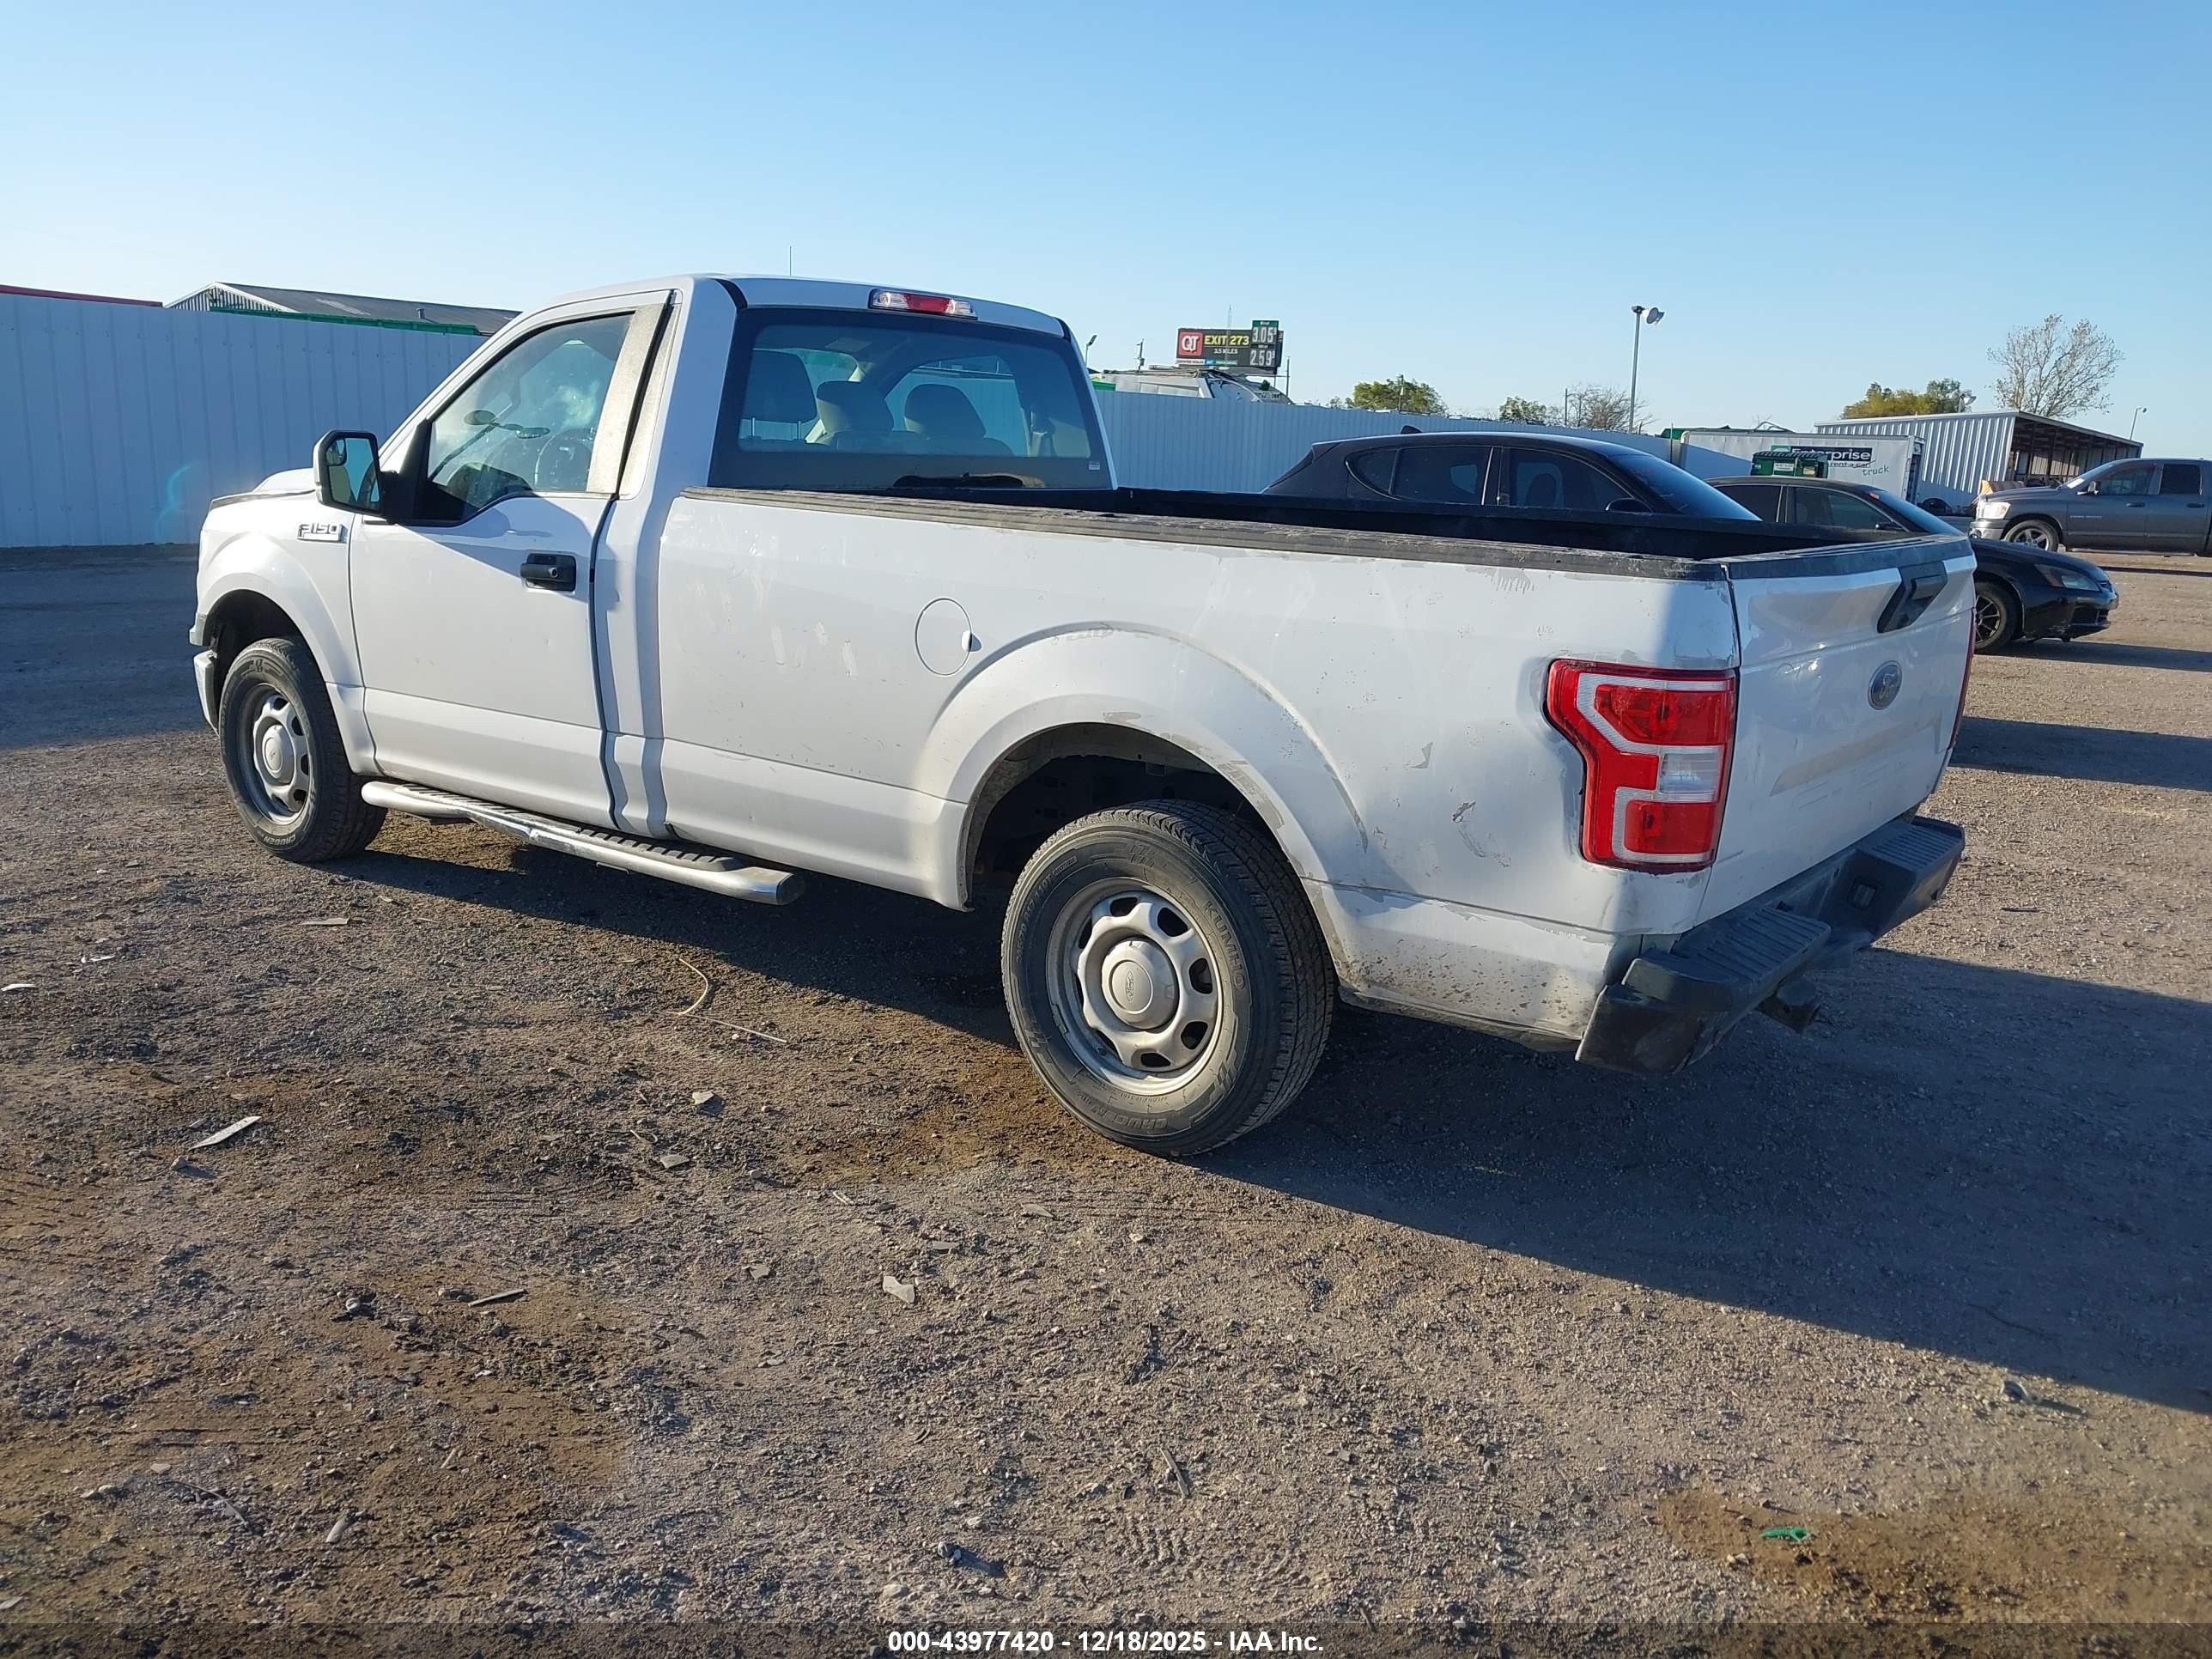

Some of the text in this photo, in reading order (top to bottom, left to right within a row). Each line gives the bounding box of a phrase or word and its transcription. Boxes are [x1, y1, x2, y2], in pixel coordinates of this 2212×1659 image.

[1204, 335, 1250, 347] EXIT 273
[1862, 464, 1890, 477] truck
[1203, 898, 1247, 991] KUMHO
